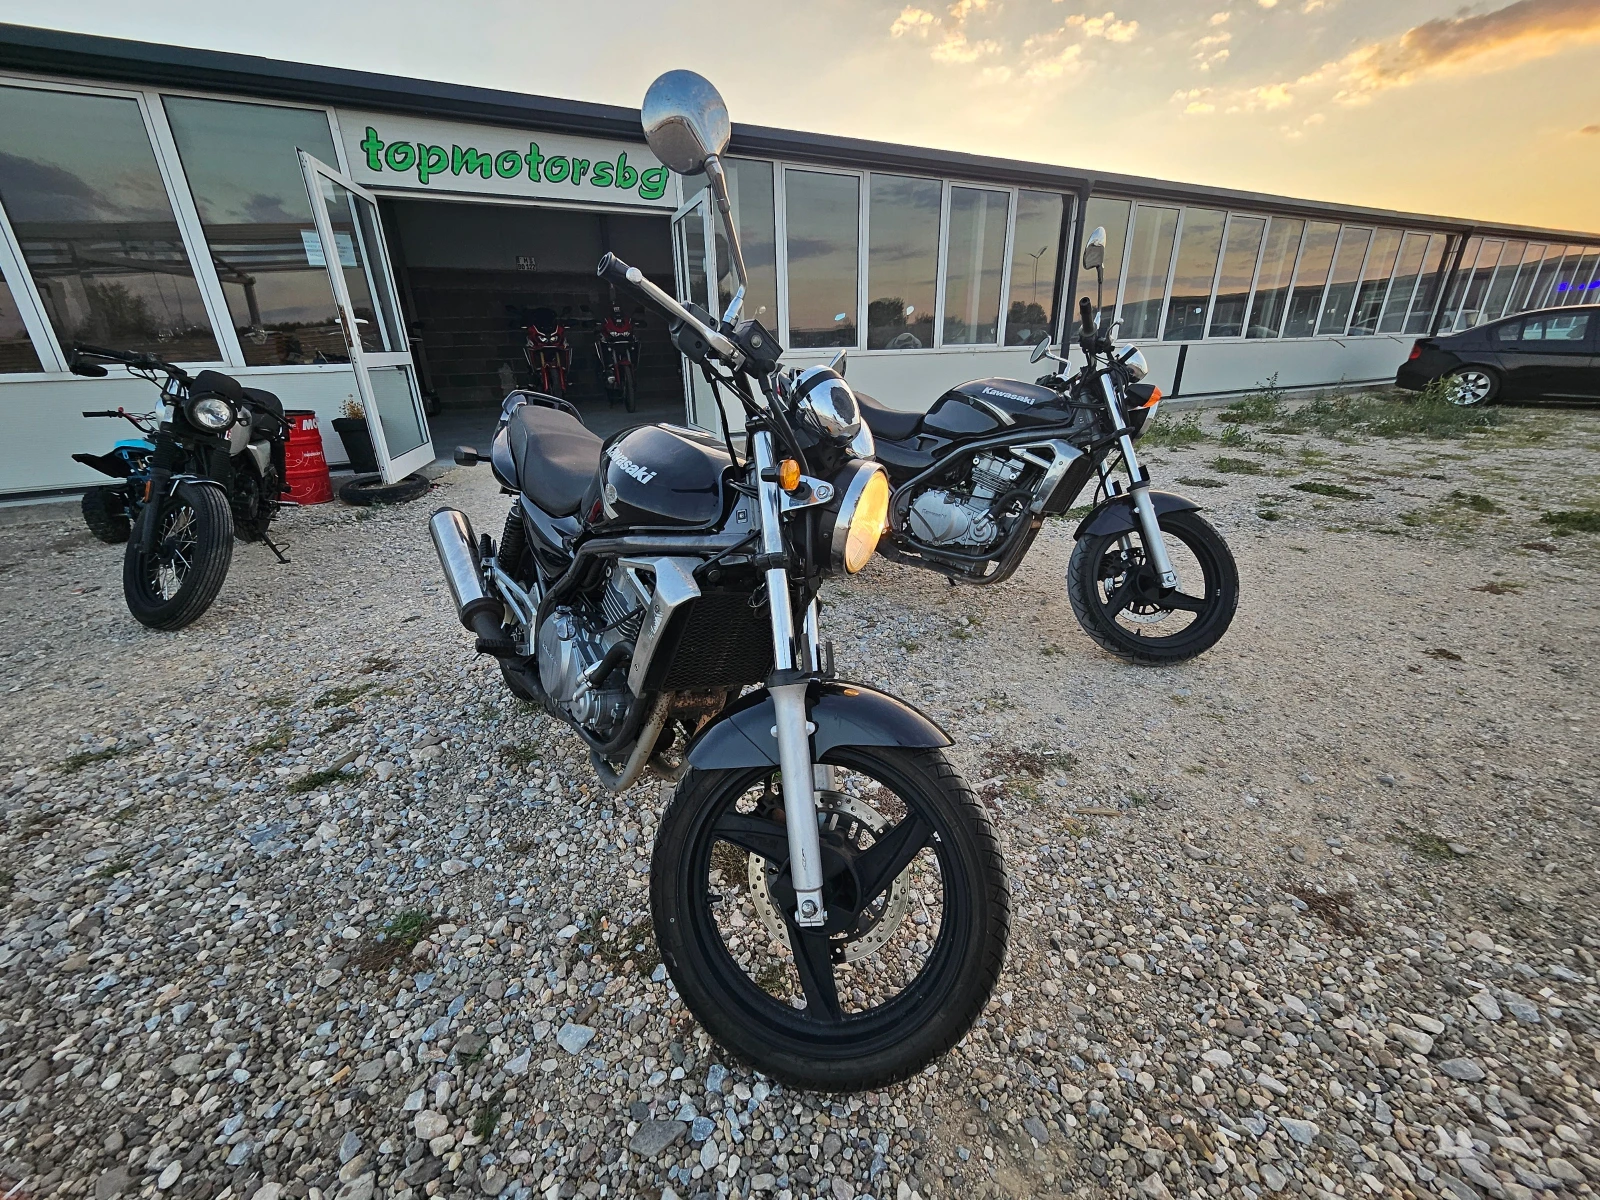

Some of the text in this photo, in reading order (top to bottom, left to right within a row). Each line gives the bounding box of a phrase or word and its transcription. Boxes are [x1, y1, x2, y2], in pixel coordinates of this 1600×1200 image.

[360, 126, 669, 199] topmotorsbg
[982, 386, 1035, 405] Kawasaki
[605, 442, 657, 485] Kawasaki
